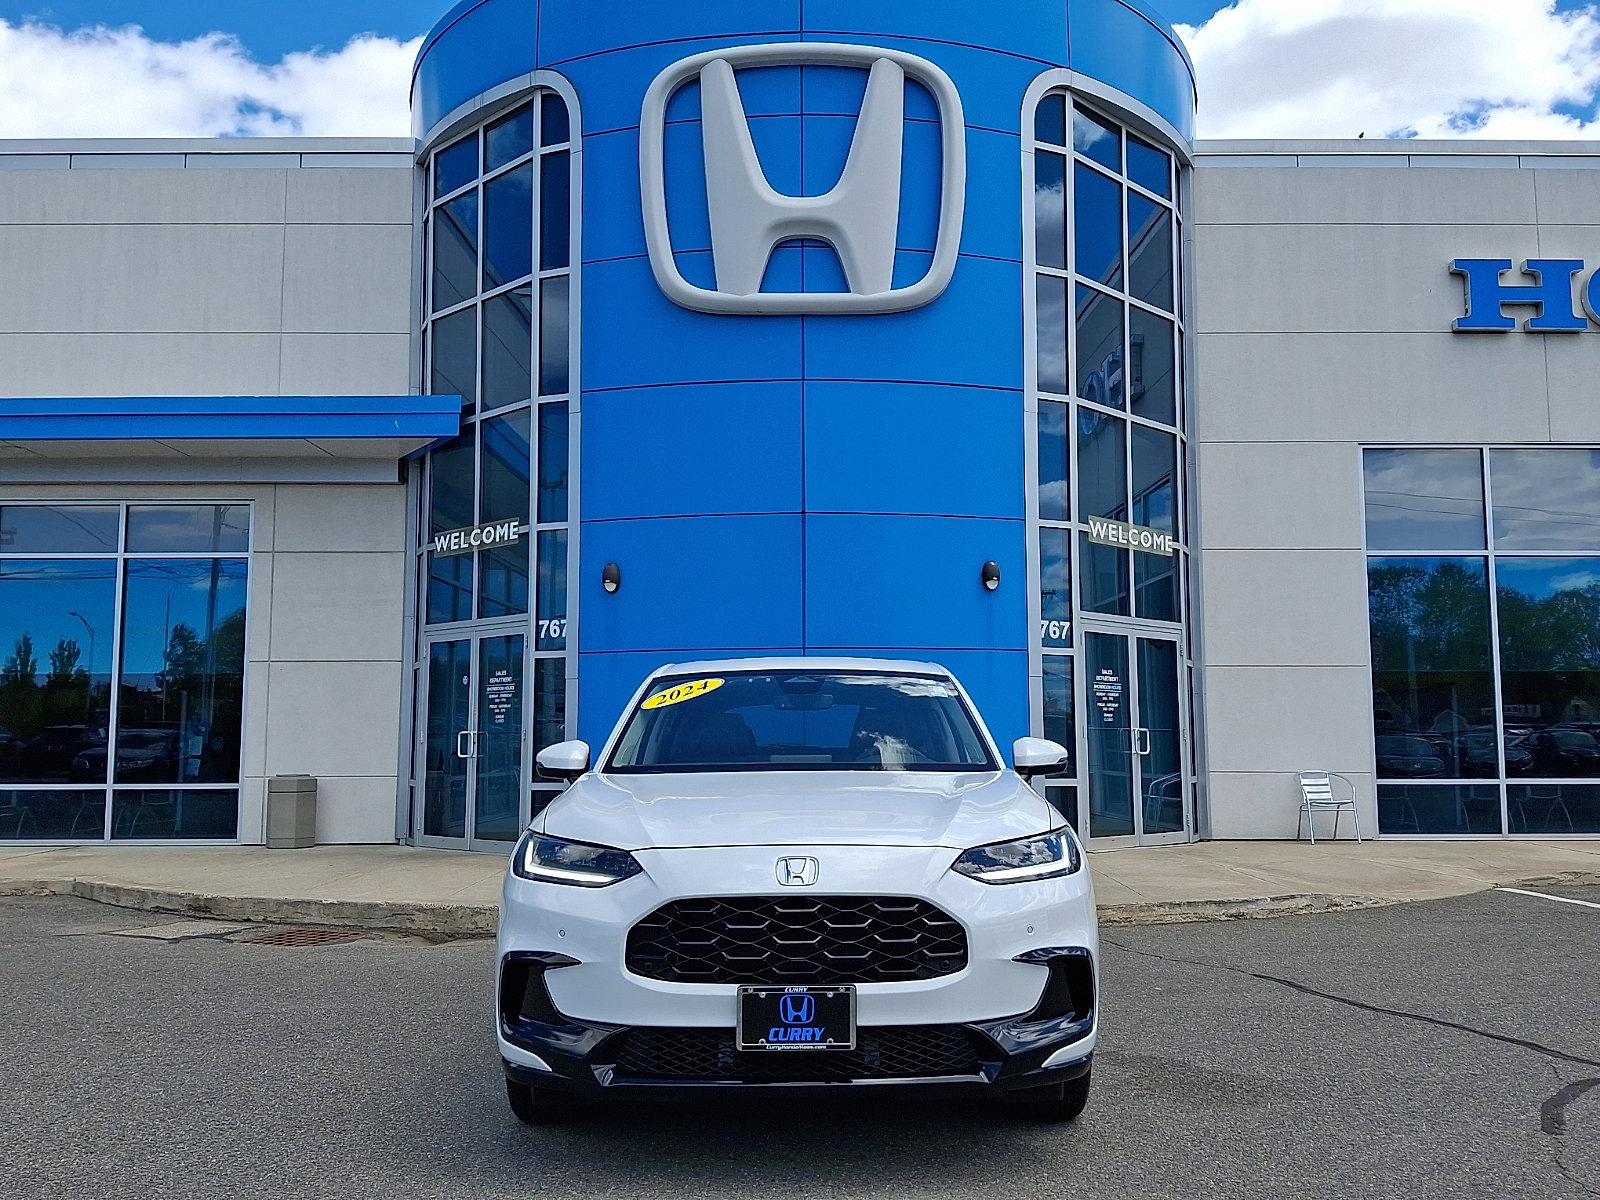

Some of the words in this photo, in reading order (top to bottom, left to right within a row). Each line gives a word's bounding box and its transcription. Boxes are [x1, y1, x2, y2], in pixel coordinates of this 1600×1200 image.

[1448, 258, 1600, 334] H
[434, 521, 519, 553] WELCOME
[1088, 519, 1174, 553] WELCOME
[538, 620, 567, 639] 767
[1040, 620, 1071, 640] 767
[656, 680, 709, 706] 2024
[768, 1027, 825, 1042] CURRY
